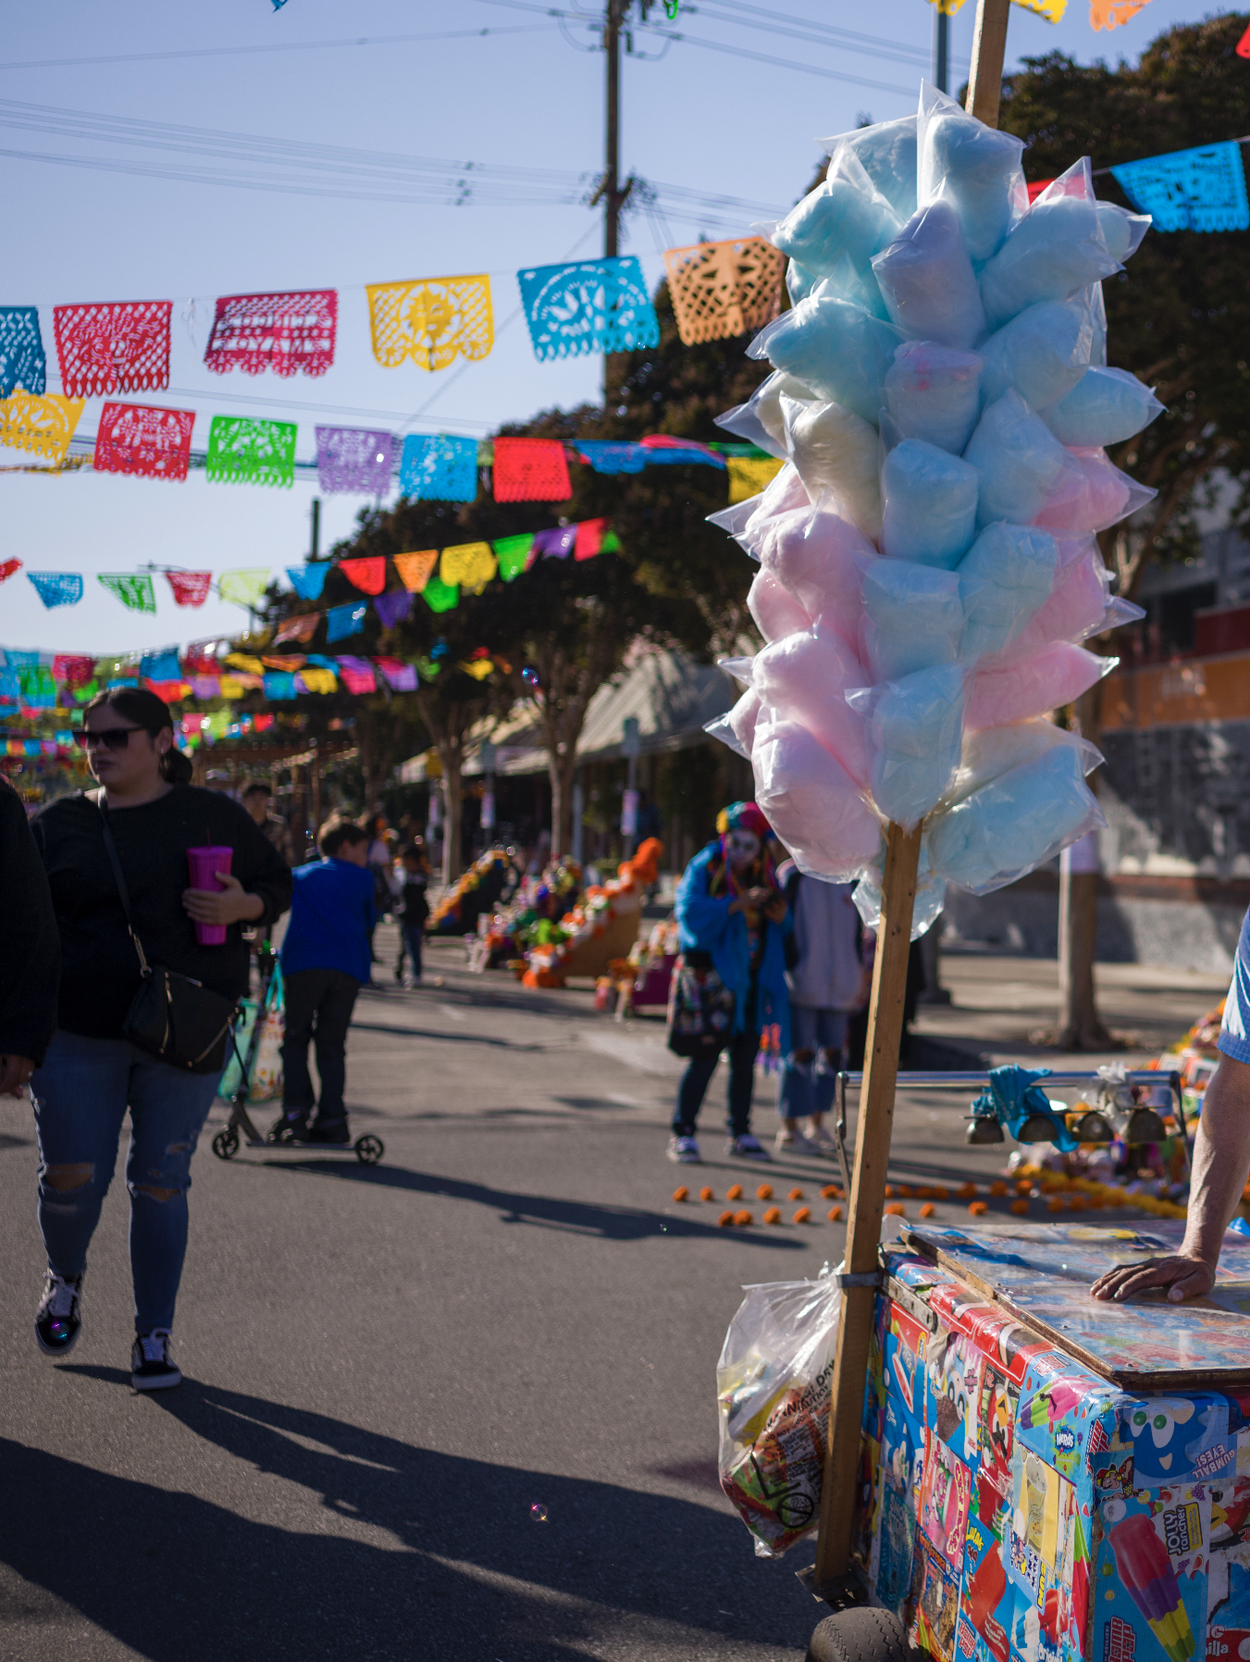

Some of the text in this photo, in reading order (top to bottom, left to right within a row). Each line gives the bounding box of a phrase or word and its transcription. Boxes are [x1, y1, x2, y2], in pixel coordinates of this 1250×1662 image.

[1191, 1449, 1236, 1479] GUMBALL
[1195, 1443, 1226, 1468] EYES!
[1165, 1511, 1181, 1555] JOLLY
[1176, 1508, 1189, 1551] rancher
[1206, 1641, 1230, 1658] illa
